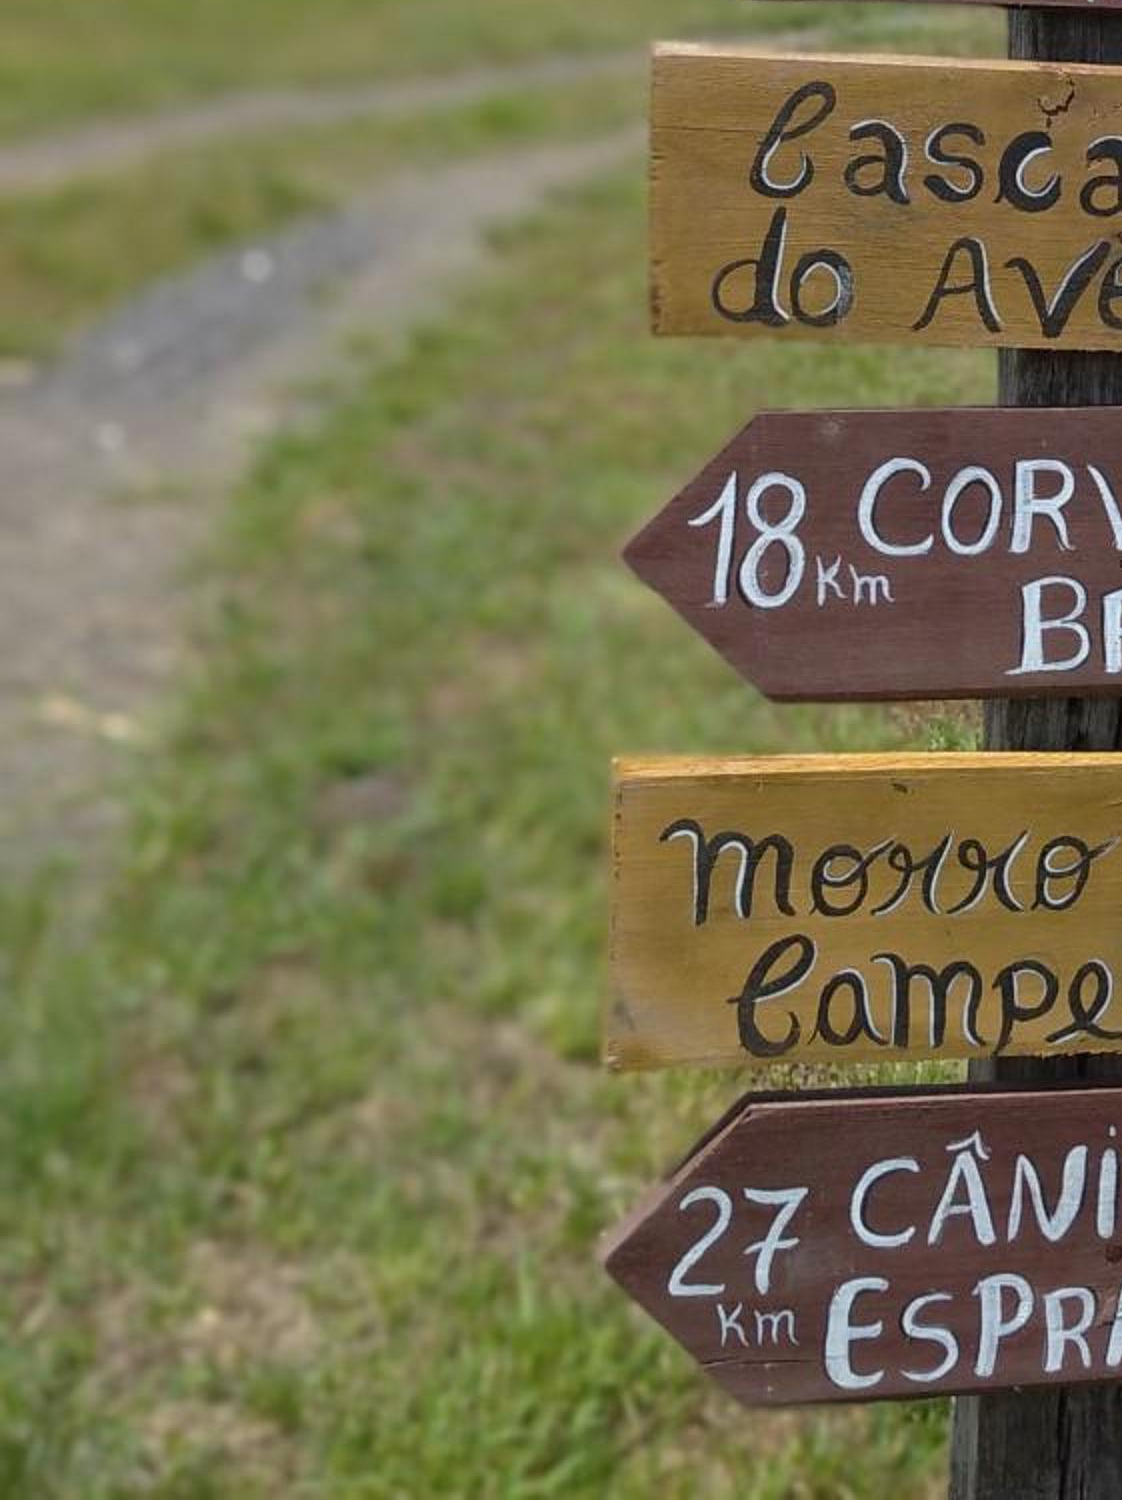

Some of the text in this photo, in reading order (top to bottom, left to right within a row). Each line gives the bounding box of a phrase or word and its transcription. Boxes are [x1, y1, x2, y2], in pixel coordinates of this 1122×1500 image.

[710, 206, 854, 328] do
[687, 469, 806, 610] 18
[667, 1185, 810, 1296] 27
